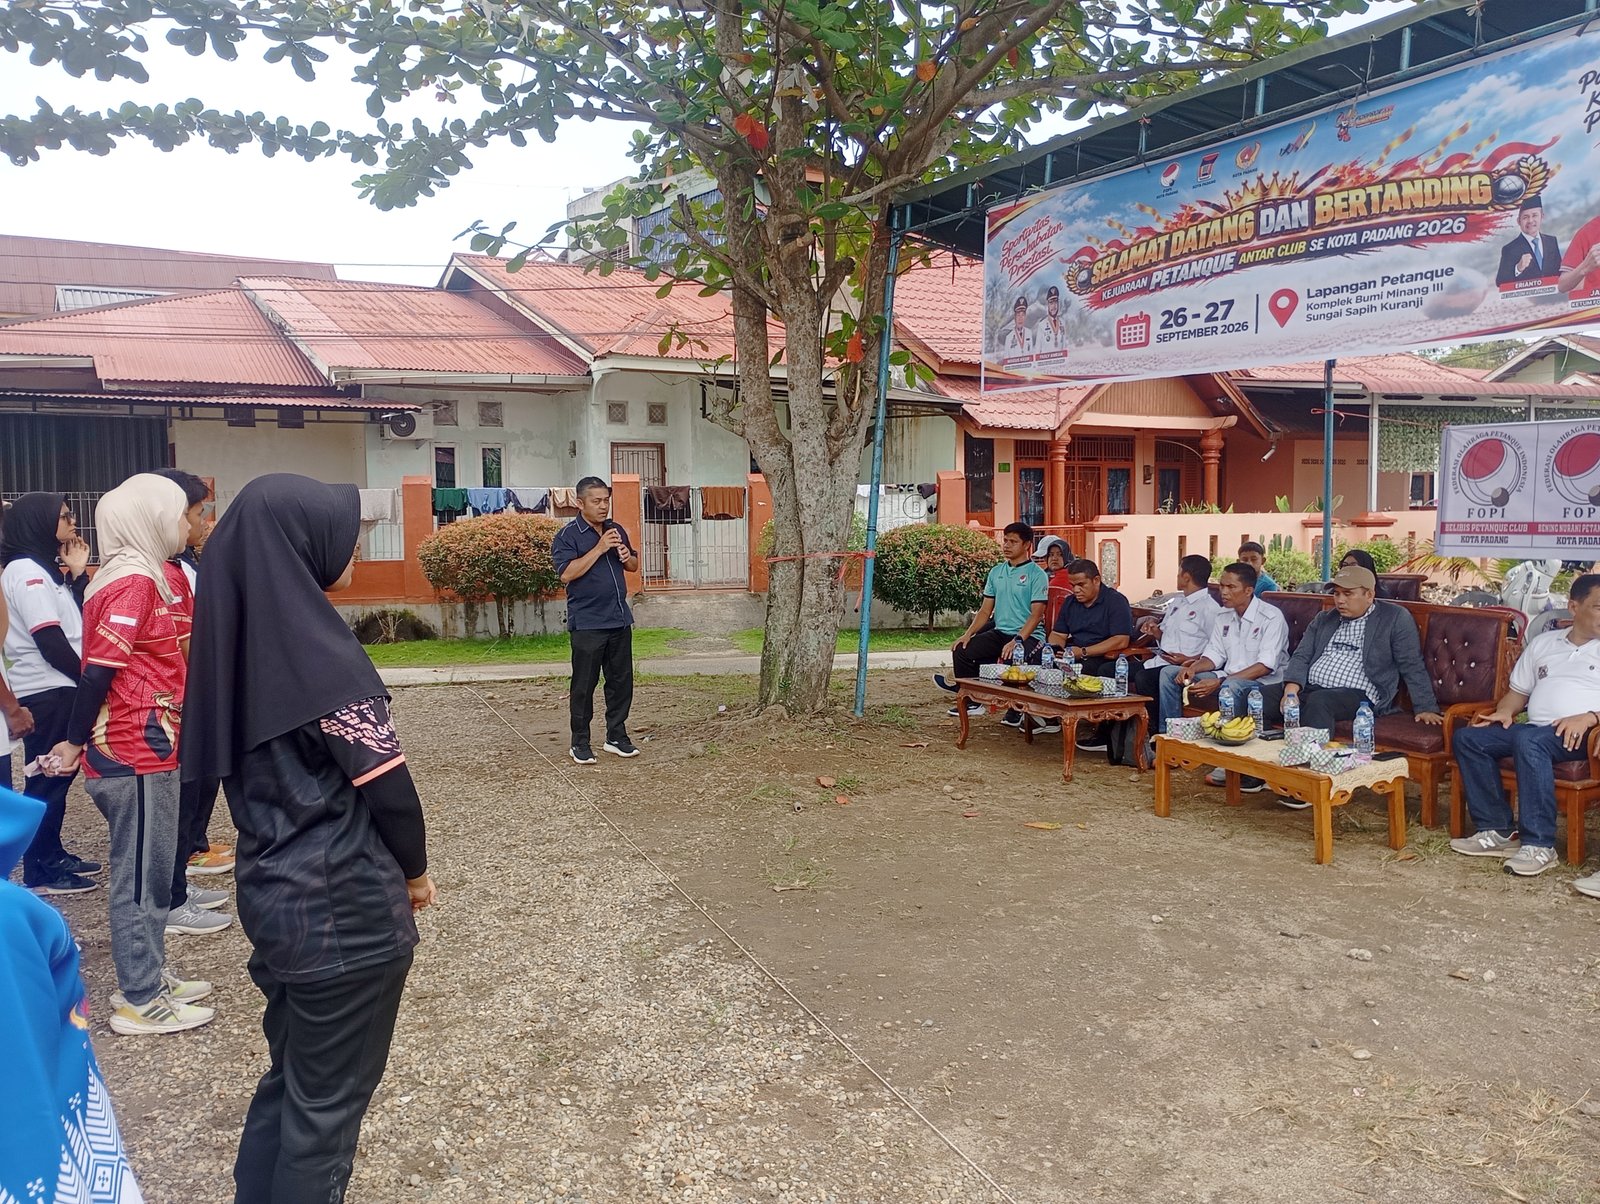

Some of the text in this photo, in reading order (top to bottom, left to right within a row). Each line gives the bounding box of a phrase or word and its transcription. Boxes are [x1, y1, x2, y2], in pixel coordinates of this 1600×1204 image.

[1002, 215, 1050, 257] Sportivitas
[1091, 174, 1492, 285] SELAMAT DATANG DAN BERTANDING
[1000, 222, 1063, 273] Persahabatan
[1102, 217, 1466, 301] KEJUARAAN PETANQUE ANTAR CLUB SE KOTA PADANG 2026
[1307, 266, 1454, 299] Lapangan Petanque
[1515, 280, 1542, 289] ERIANTO
[1306, 282, 1443, 311] Komplek Bumi Minang III
[1306, 297, 1423, 322] Sungai Sapih Kuranji
[1156, 321, 1248, 343] SEPTEMBER 2026
[1452, 431, 1528, 495] FEDERASI OLAHRAGA PETANQUE INDONESIA
[1544, 455, 1553, 493] FEDERASI
[1549, 425, 1585, 454] OLAHRAGA
[1467, 508, 1505, 519] FOPI
[1563, 507, 1596, 518] FOP
[1445, 523, 1528, 533] BELIBIS PETANQUE CLUB
[1461, 535, 1509, 544] KOTA PADANG
[1556, 536, 1577, 545] KOTA
